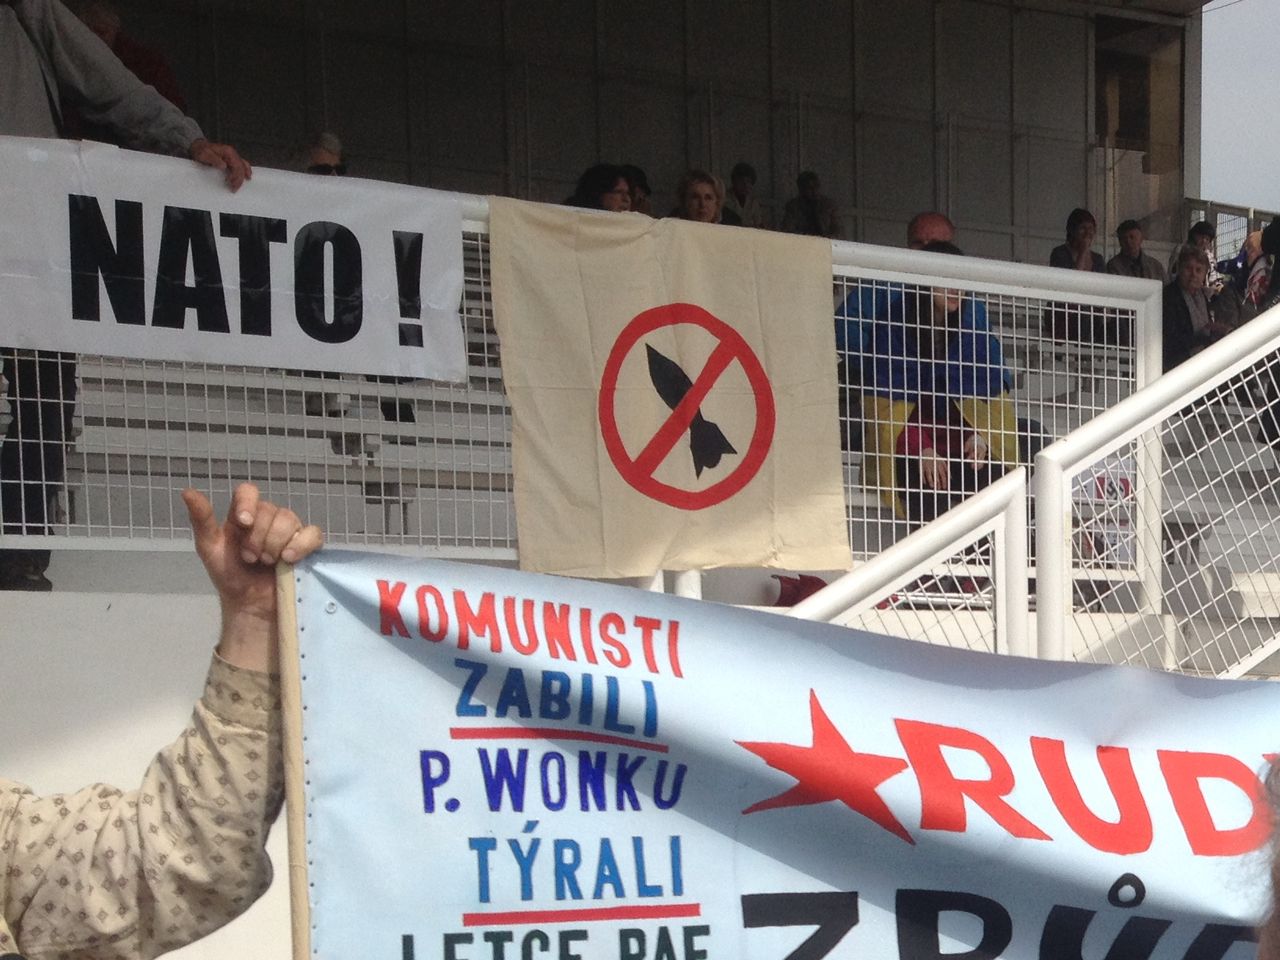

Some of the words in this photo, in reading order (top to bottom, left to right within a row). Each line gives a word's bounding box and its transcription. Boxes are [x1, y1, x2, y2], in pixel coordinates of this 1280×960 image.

[376, 579, 684, 678] KOMUNISTI
[454, 658, 658, 738] ZABILI
[419, 750, 461, 814] P.
[478, 747, 688, 814] WONKU
[468, 820, 684, 903] TÝRALI
